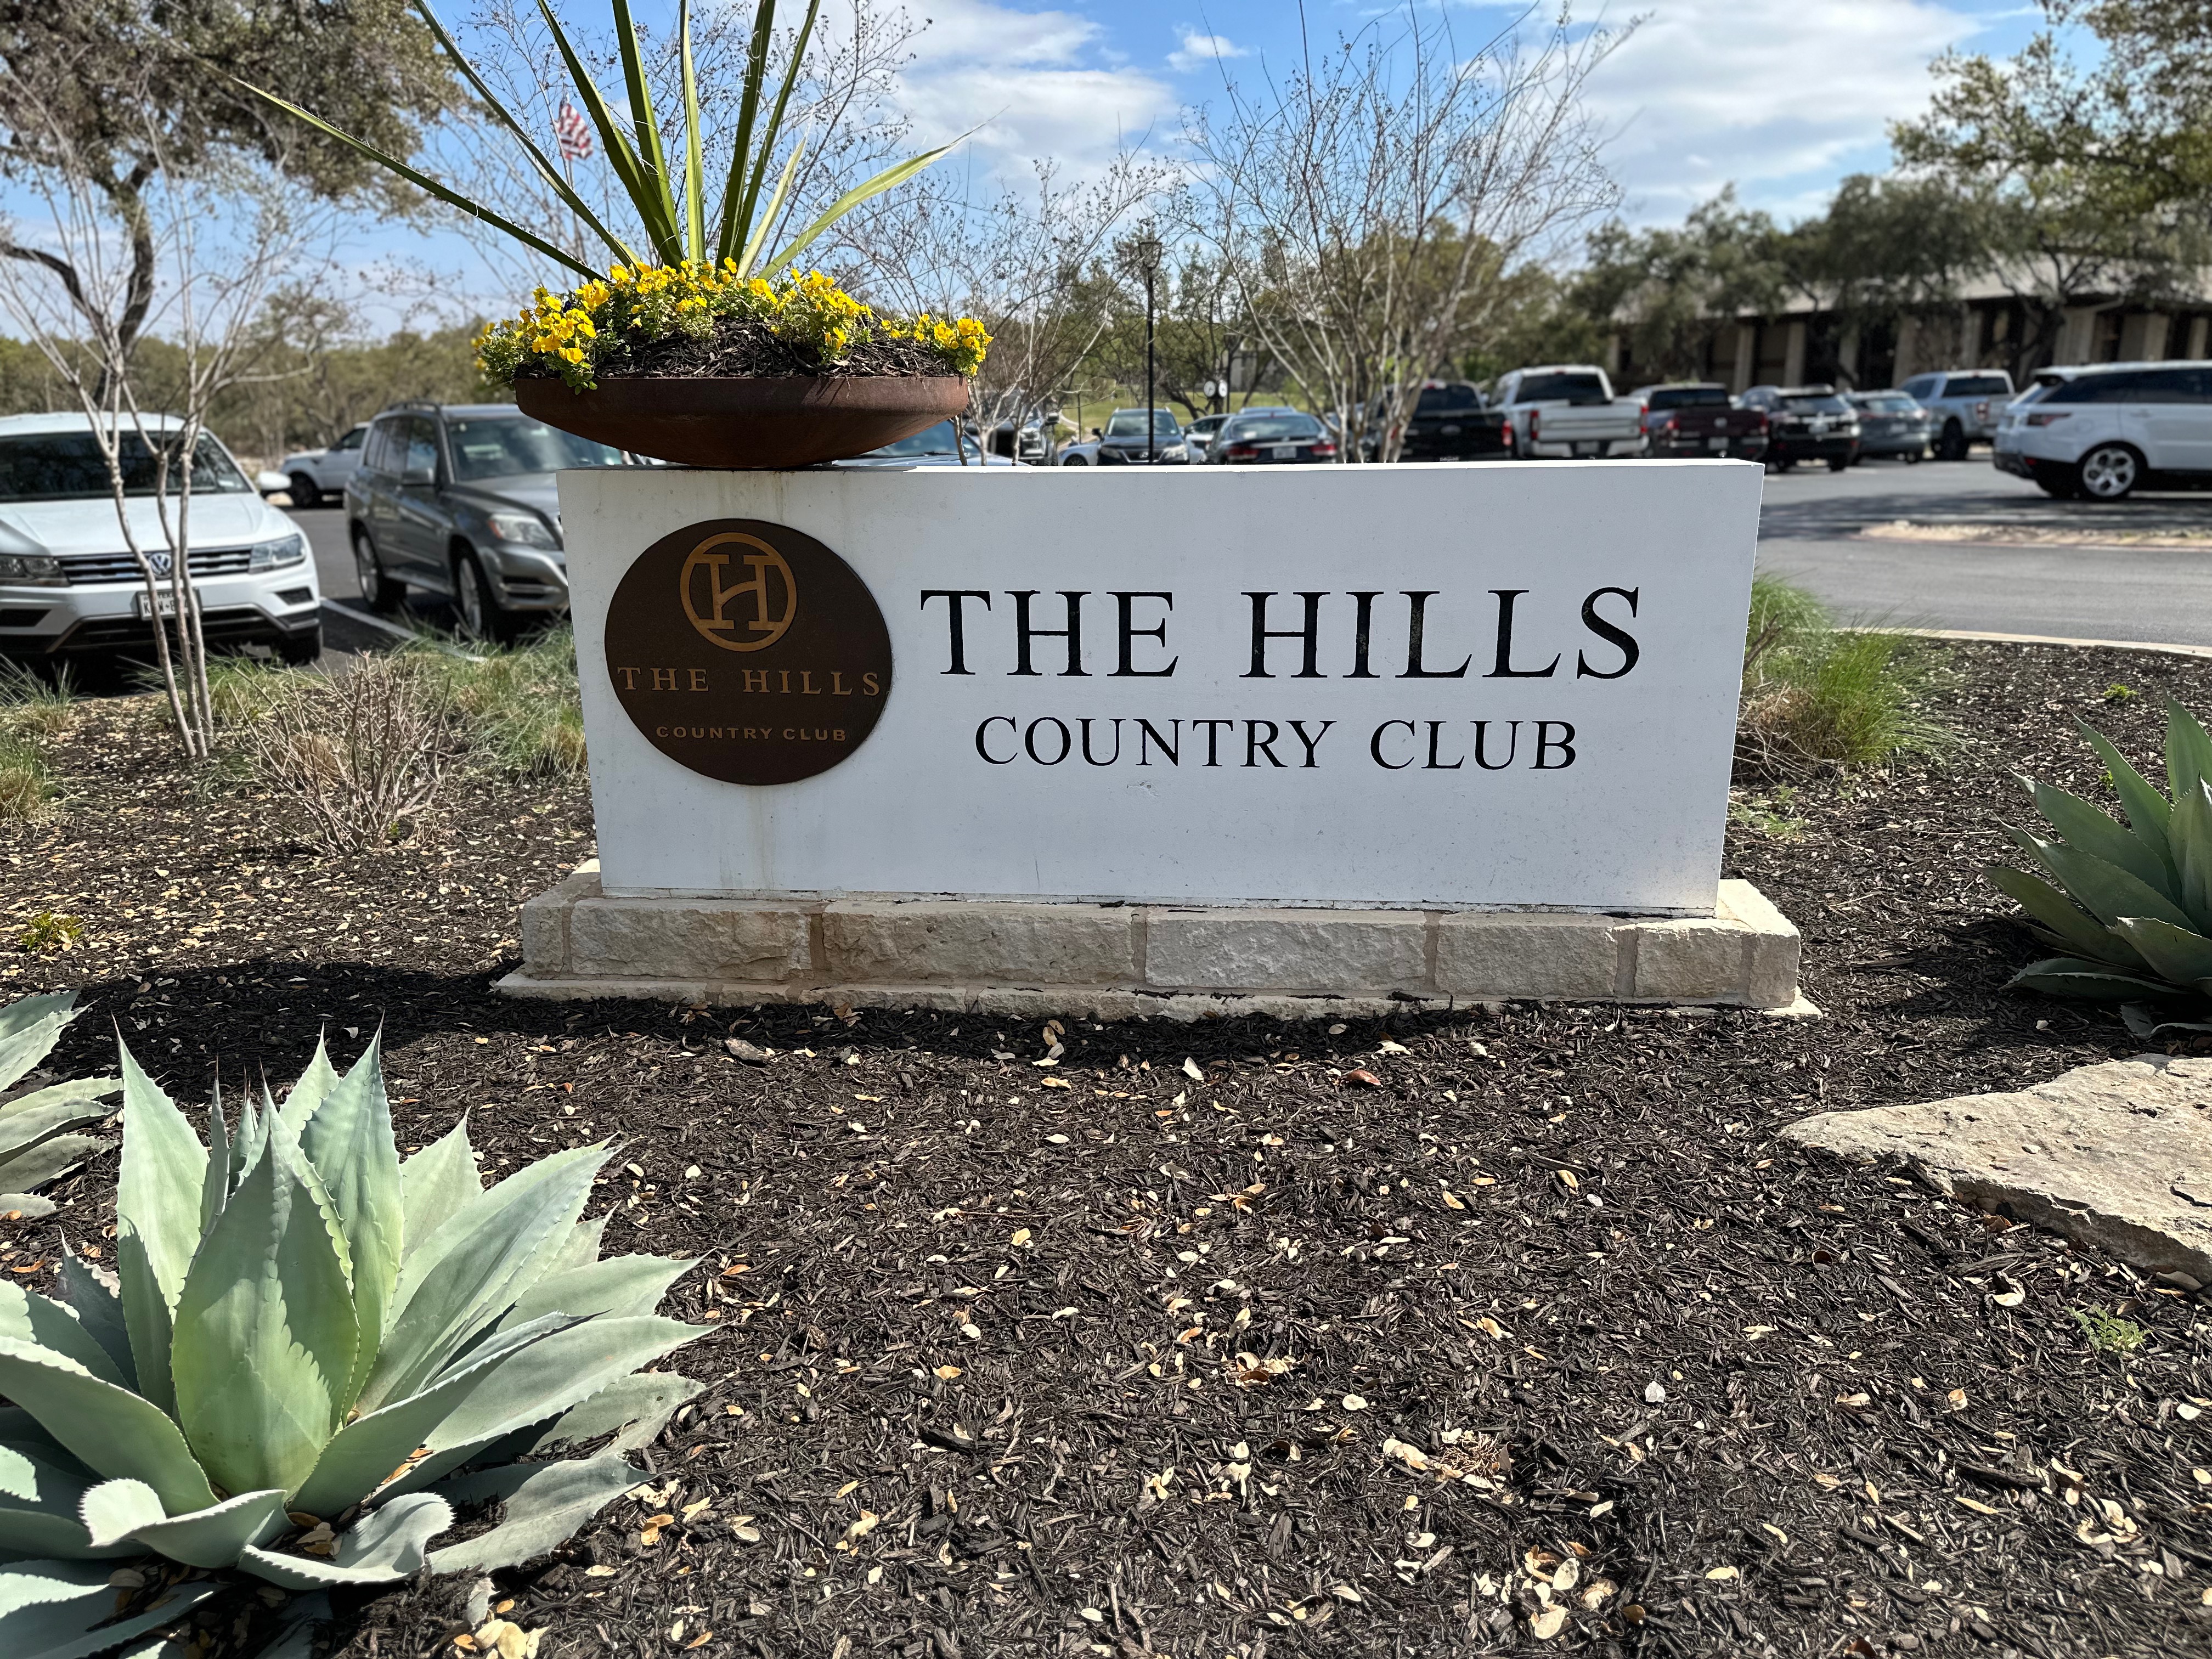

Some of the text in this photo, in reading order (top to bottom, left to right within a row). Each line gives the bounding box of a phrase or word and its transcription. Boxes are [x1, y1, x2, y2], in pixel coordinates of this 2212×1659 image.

[920, 586, 1640, 680] THE HILLS
[617, 667, 880, 697] THE HILLS
[656, 726, 847, 741] COUNTRY CLUB
[975, 716, 1576, 770] COUNTRY CLUB
